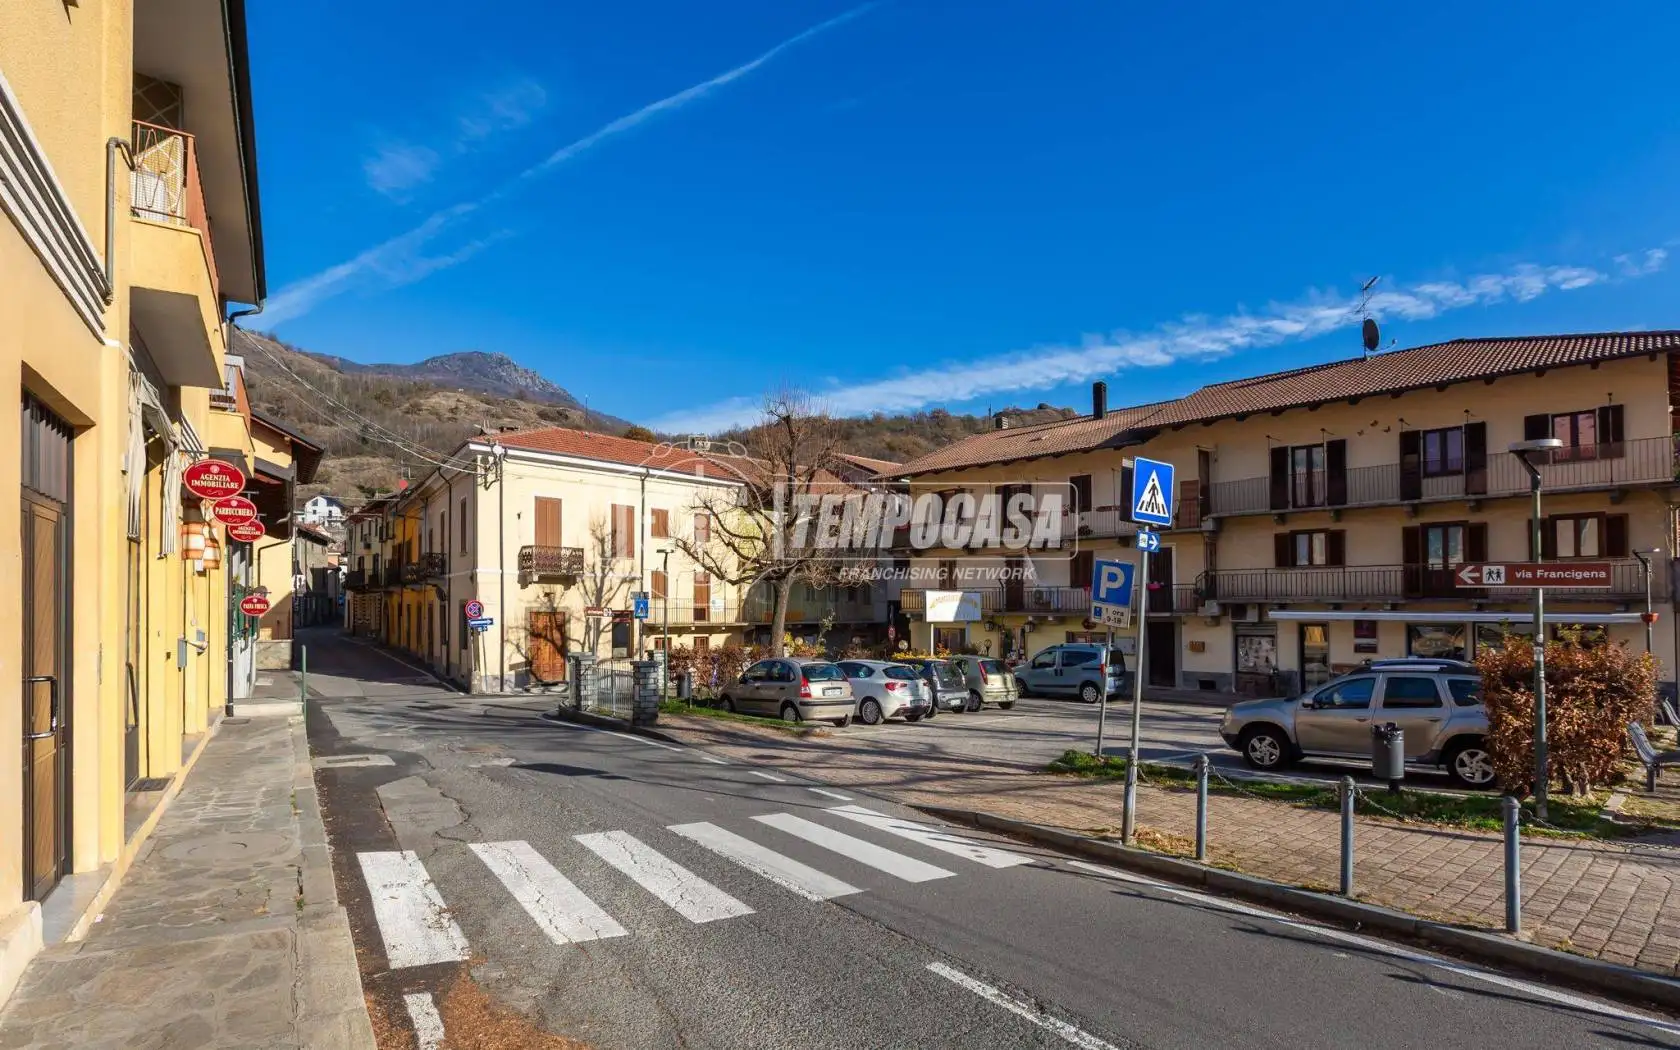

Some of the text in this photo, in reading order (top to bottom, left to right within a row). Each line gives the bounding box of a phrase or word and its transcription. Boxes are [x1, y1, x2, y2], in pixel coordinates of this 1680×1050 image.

[200, 473, 230, 482] AGENZIA
[191, 480, 239, 489] IMMOBILIARE
[1515, 569, 1606, 580] via Francigena
[1100, 565, 1124, 598] P
